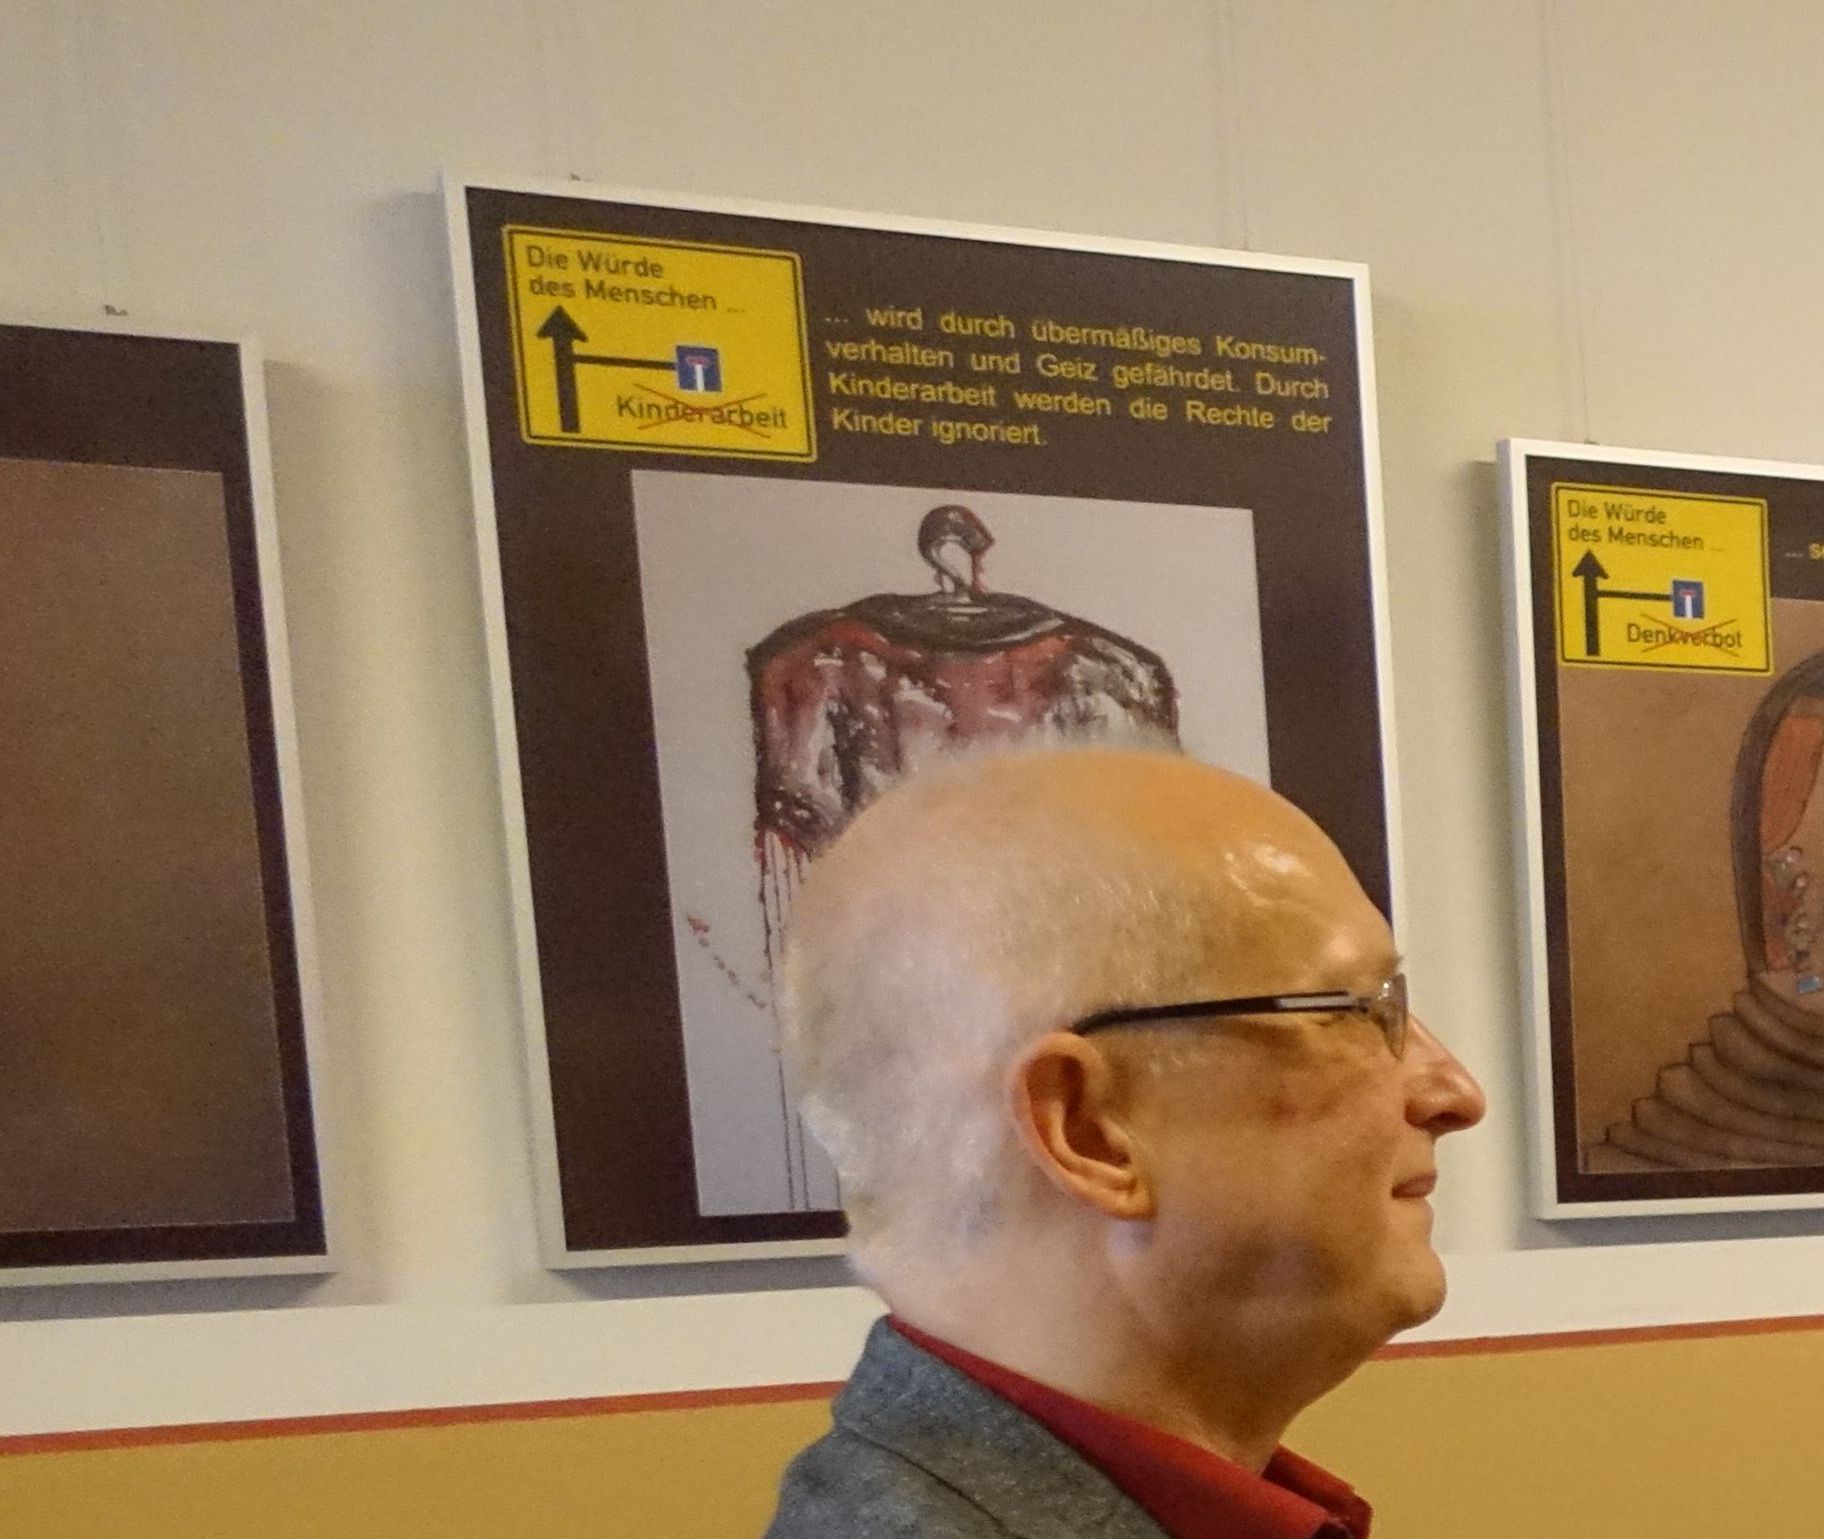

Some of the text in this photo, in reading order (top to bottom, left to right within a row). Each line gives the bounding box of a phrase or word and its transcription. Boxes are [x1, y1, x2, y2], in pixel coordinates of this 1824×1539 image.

[526, 245, 664, 279] Die Würde
[529, 277, 576, 297] des
[585, 279, 717, 310] Menschen
[866, 305, 923, 331] wird
[939, 311, 1015, 339] durch
[1032, 318, 1202, 357] übermäßiges
[1215, 334, 1327, 366] Konsum-
[826, 339, 954, 368] verhalten
[971, 352, 1021, 374] und
[1036, 353, 1098, 381] Geiz
[1256, 372, 1330, 399] Durch
[616, 395, 788, 429] Kinderarbeit
[829, 372, 1333, 433] Kinderarbeit werden die Rechte der
[832, 408, 922, 436] Kinder
[1568, 500, 1667, 524] Die Würde
[1569, 524, 1601, 542] des
[1608, 526, 1704, 550] Menschen
[1627, 623, 1743, 648] Denkverbot
